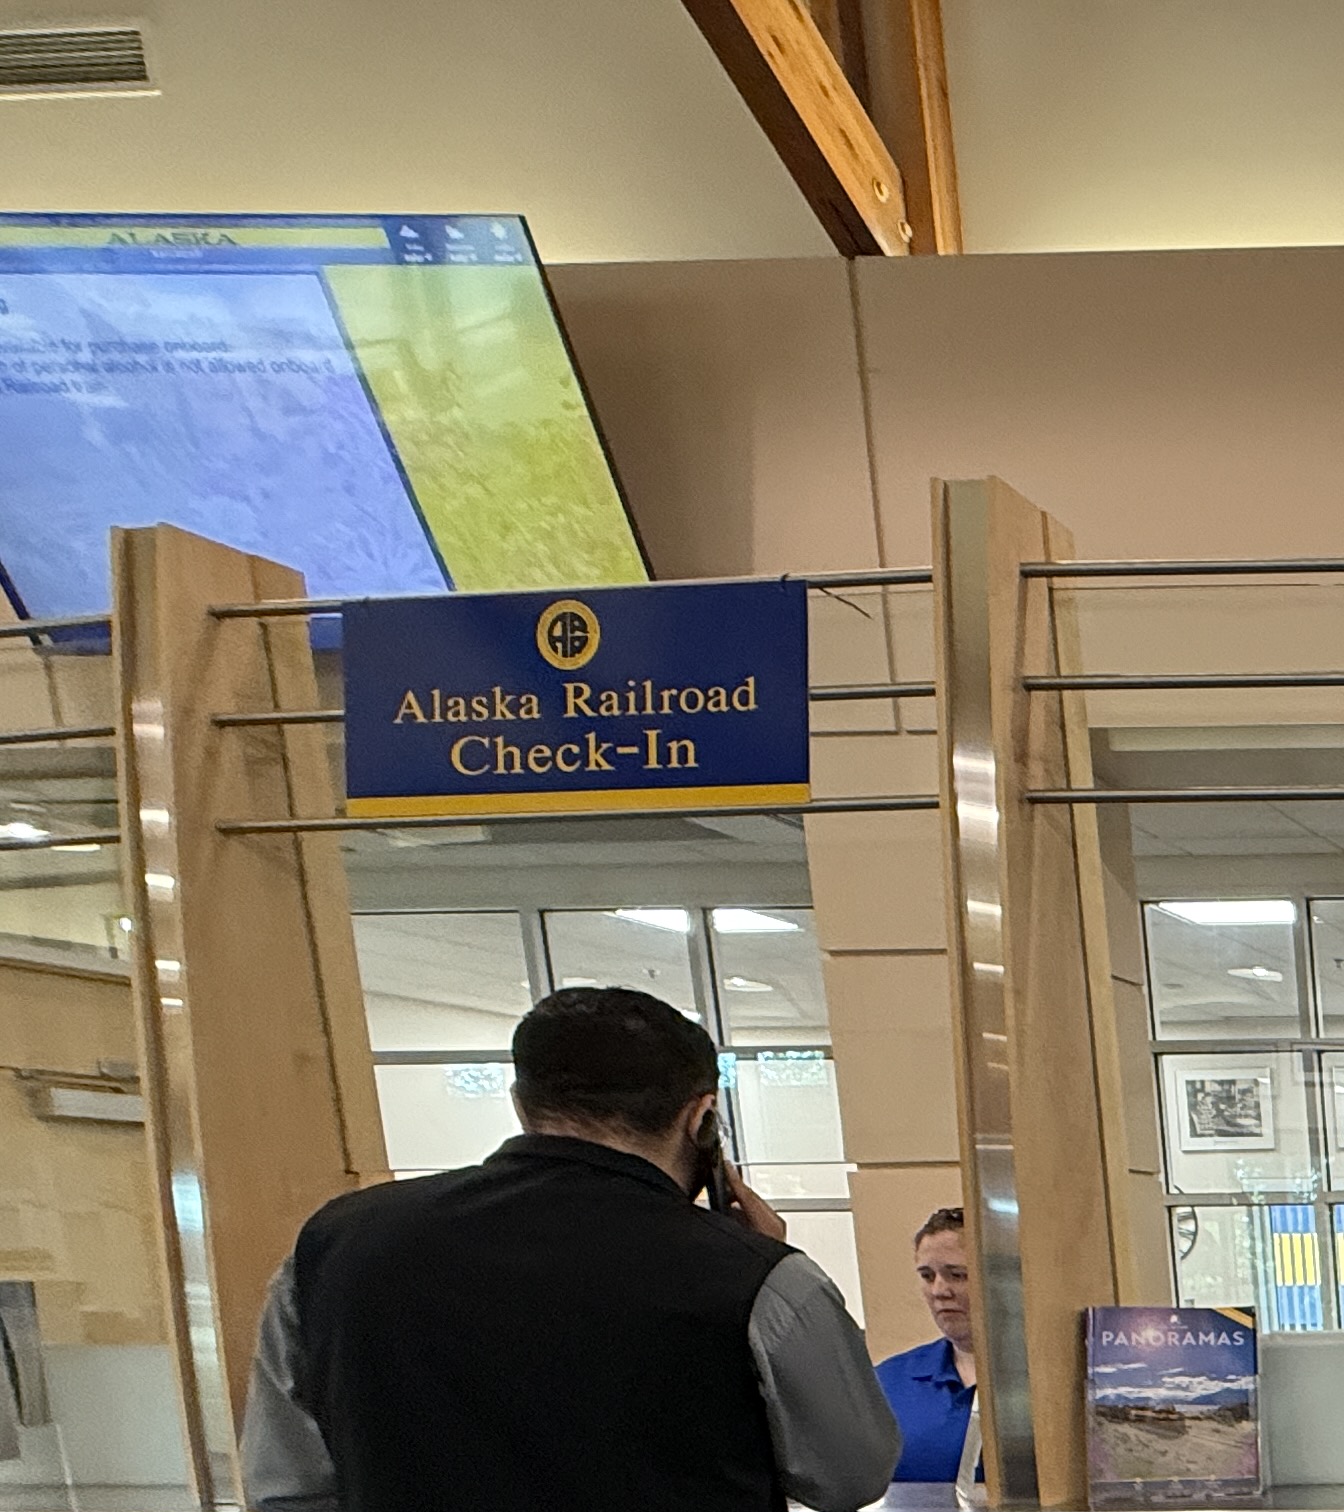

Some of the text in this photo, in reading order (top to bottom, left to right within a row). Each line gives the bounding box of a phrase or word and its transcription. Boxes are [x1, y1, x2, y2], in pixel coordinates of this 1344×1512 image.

[393, 676, 759, 725] Alaska Railroad
[450, 728, 700, 776] Check-In
[1102, 1329, 1245, 1347] PANORAMAS
